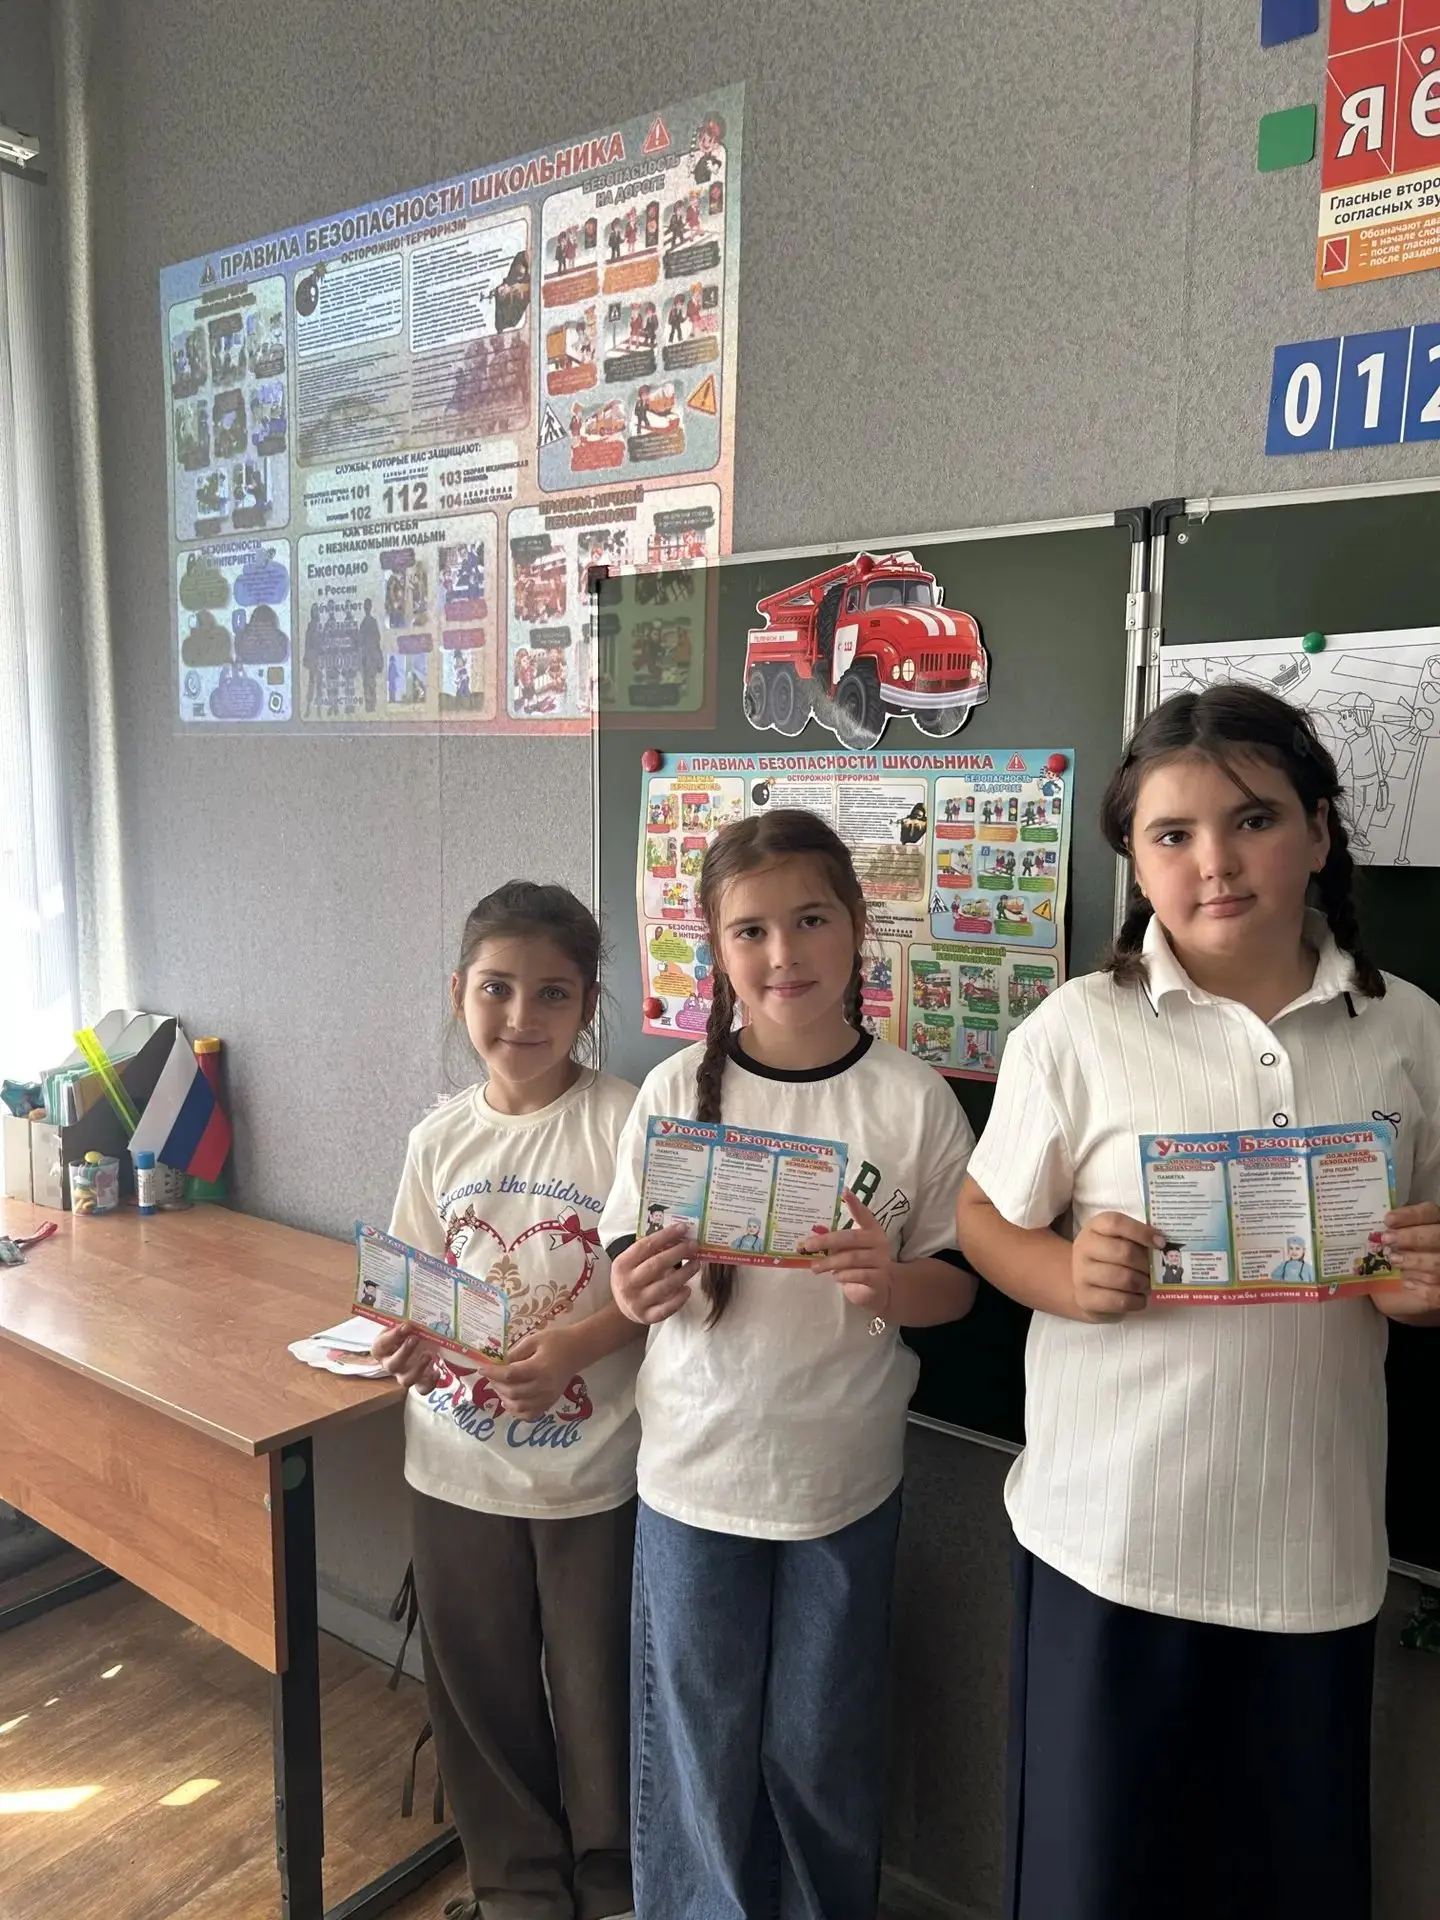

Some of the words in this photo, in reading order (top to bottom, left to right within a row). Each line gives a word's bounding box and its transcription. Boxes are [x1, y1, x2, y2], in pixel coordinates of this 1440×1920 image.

[582, 156, 680, 194] БЕЗОПАСНОСТЬ
[615, 174, 665, 206] ДОРОГЕ
[1330, 188, 1392, 210] Гласные
[220, 236, 300, 279] ПРАВИЛА
[305, 185, 464, 253] БЕЗОПАСНОСТИ
[470, 132, 625, 205] ШКОЛЬНИКА
[1334, 199, 1413, 224] согласных
[405, 218, 467, 246] ТЕРРОРИЗМ
[1360, 221, 1421, 240] Обозначают
[1380, 232, 1416, 245] начале
[1371, 245, 1400, 257] после
[1370, 255, 1399, 266] после
[1284, 362, 1322, 437] 0
[1357, 352, 1385, 429] 1
[372, 454, 410, 469] КОТОРЫЕ
[411, 452, 427, 463] НАС
[440, 470, 462, 486] 103
[350, 484, 370, 499] 101
[383, 482, 428, 514] 112
[440, 493, 462, 509] 104
[350, 506, 371, 520] 102
[363, 523, 392, 534] ВЕСТИ
[393, 519, 419, 531] СЕБЯ
[326, 537, 400, 554] НЕЗНАКОМЫМИ
[401, 530, 446, 546] ЛЮДЬМИ
[307, 561, 368, 579] Ежегодно
[325, 584, 357, 596] России
[692, 758, 755, 771] ПРАВИЛА
[759, 755, 876, 771] БЕЗОПАСНОСТИ
[882, 755, 993, 770] ШКОЛЬНИКА
[787, 774, 833, 782] ОСТОРОЖНО!
[835, 774, 880, 782] ТЕРРОРИЗМ
[964, 774, 1032, 783] БЕЗОПАСНОСТЬ
[724, 1130, 835, 1156] БЕЗОПАСНОСТИ
[1239, 1131, 1374, 1153] БЕЗОПАСНОСТИ
[497, 1174, 527, 1193] the
[530, 1178, 605, 1214] wildrne
[507, 1413, 584, 1449] Club
